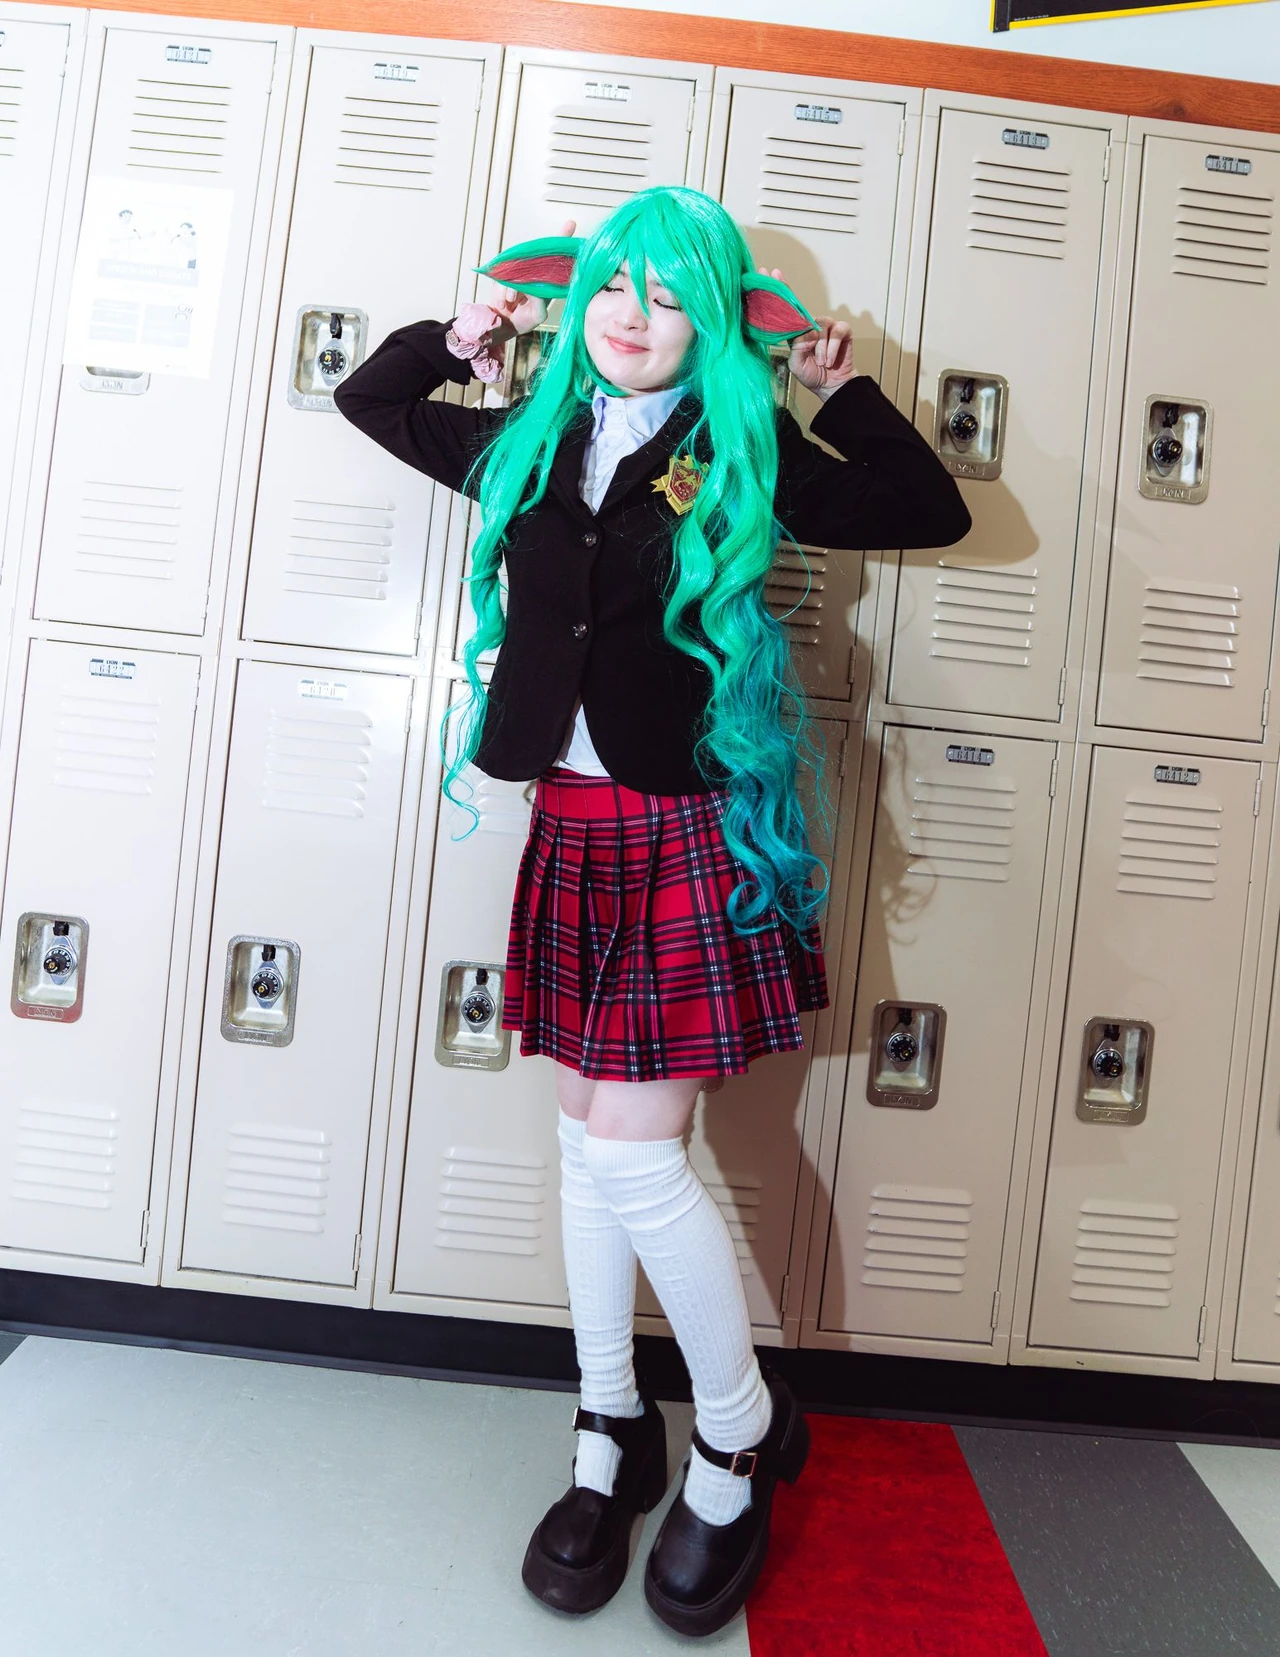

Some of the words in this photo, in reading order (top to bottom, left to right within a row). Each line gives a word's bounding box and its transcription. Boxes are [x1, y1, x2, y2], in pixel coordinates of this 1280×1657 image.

[175, 50, 199, 61] 6421
[805, 109, 830, 121] 6415
[1012, 134, 1037, 145] 6413
[1215, 160, 1239, 171] 6411
[99, 664, 124, 676] 6422
[957, 750, 982, 762] 6414
[1164, 770, 1189, 782] 6412
